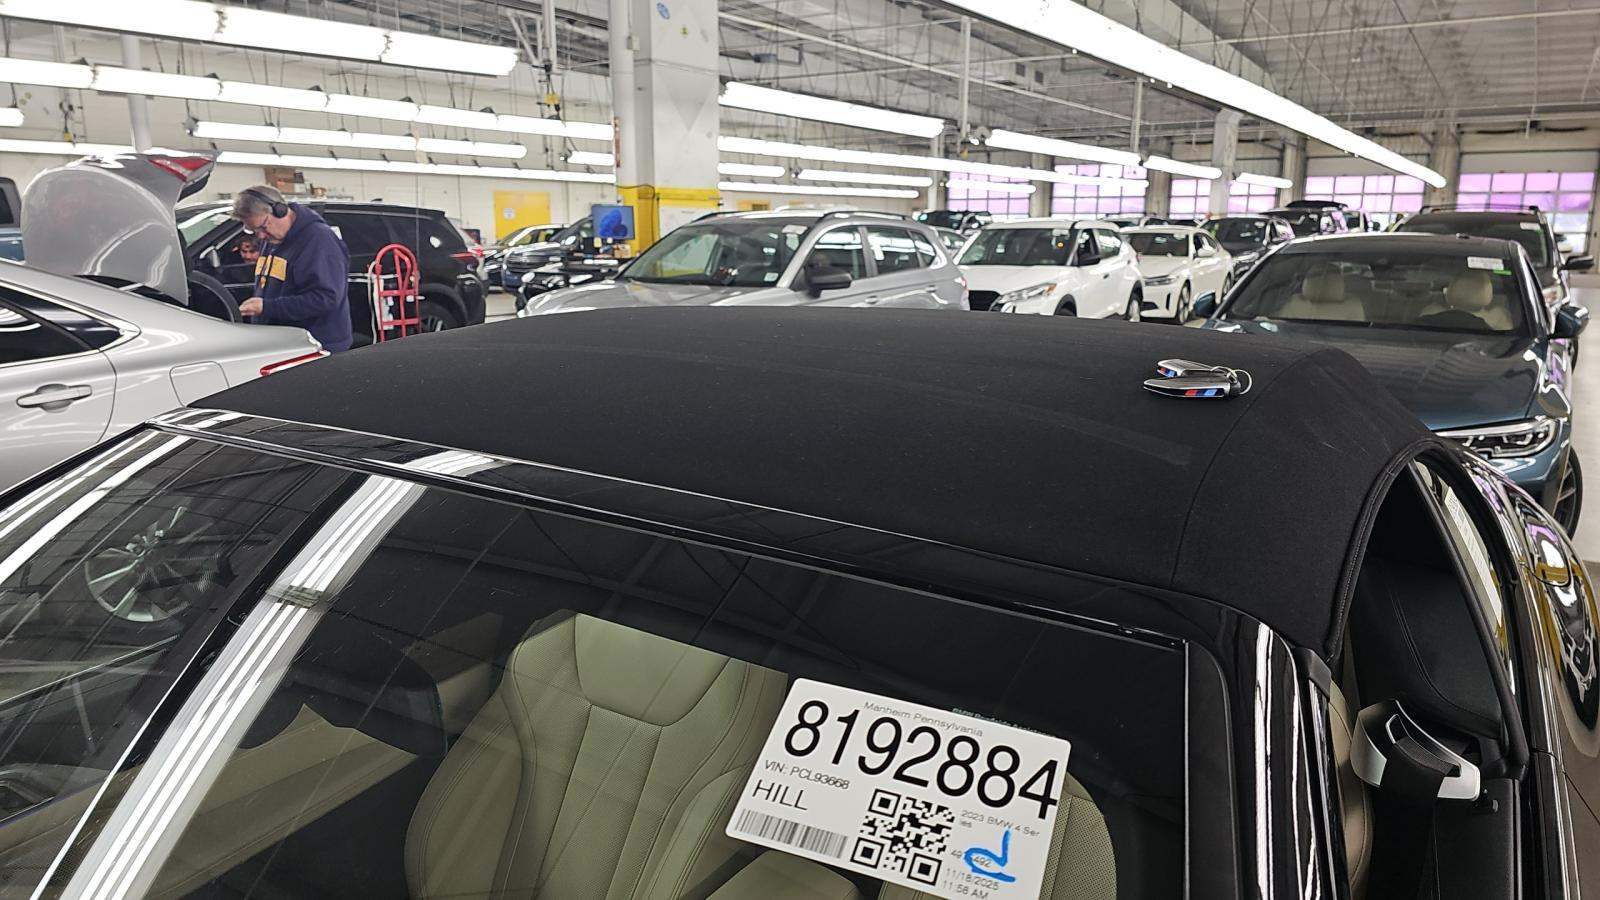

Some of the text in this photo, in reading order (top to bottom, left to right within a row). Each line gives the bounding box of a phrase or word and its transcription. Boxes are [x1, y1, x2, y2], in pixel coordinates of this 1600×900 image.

[864, 701, 983, 737] Manheim Pennsylvania
[765, 760, 850, 789] VIN: PCL93668
[784, 700, 1058, 820] 8192884
[752, 779, 807, 811] HILL
[961, 810, 984, 822] 2023
[987, 816, 1014, 829] BMW
